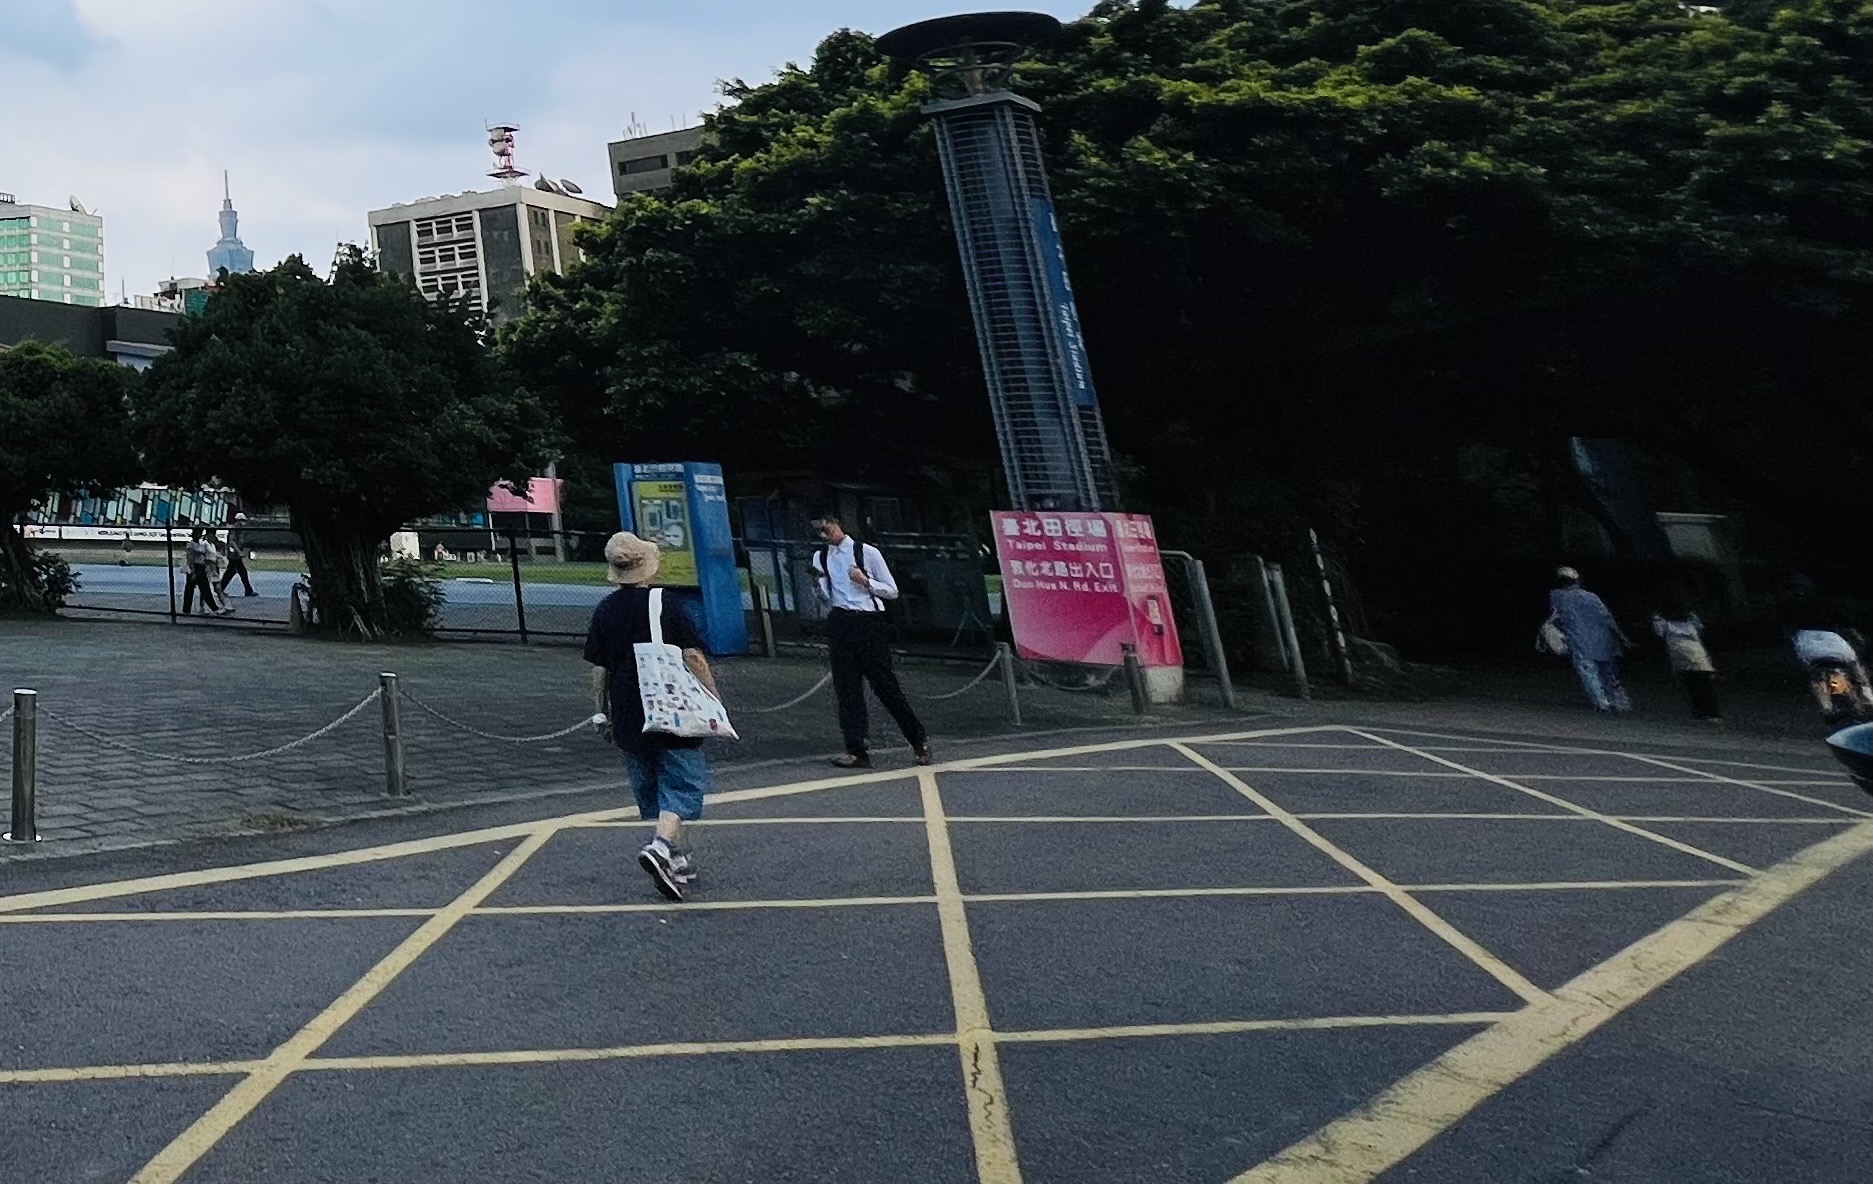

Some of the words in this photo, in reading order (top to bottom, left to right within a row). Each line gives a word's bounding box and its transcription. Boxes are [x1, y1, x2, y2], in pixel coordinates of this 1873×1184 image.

[1002, 518, 1107, 538] 臺北田徑場
[1007, 539, 1047, 551] Taipei
[1053, 541, 1108, 553] Stadium
[1094, 583, 1119, 593] Exit
